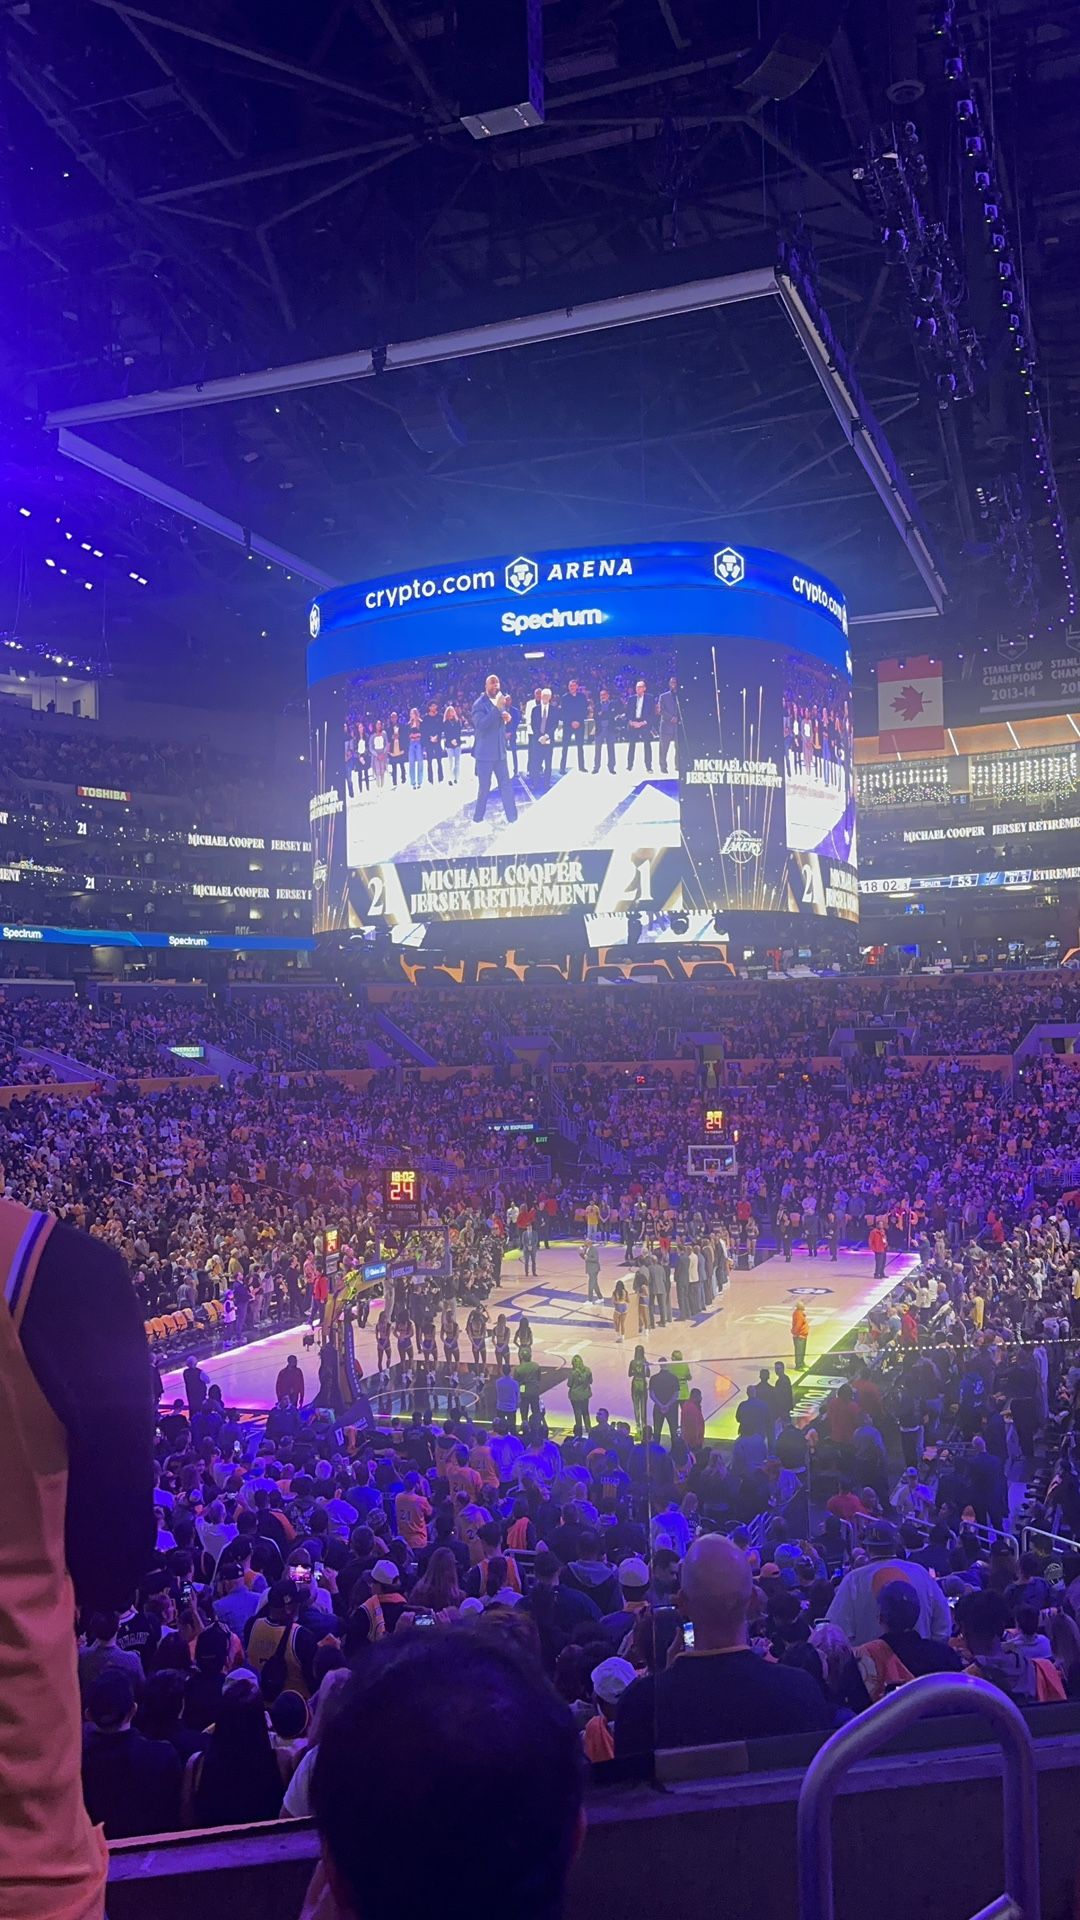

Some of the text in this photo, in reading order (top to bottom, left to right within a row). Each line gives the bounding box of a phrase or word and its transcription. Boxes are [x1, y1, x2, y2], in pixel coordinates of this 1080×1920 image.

[365, 558, 633, 609] crypto.com ARENA
[501, 608, 602, 636] Spectrum
[983, 661, 1043, 676] STANLEY CUP
[983, 671, 1043, 686] CHAMPIONS
[991, 685, 1035, 701] 2013-14
[693, 758, 777, 775] MICHAEL COOPER
[686, 771, 782, 788] JERSEY RETIREMENT
[81, 786, 127, 801] TOSHIBA
[77, 822, 87, 835] 21
[904, 830, 946, 843] MICHAEL
[946, 826, 985, 838] COOPER
[992, 821, 1027, 835] JERSEY
[188, 833, 228, 847] MICHAEL
[229, 837, 264, 849] COOPER
[271, 840, 301, 852] JERSEY
[85, 877, 95, 889] 21
[421, 861, 584, 892] MICHAEL COOPER
[958, 876, 972, 886] 53
[193, 884, 233, 898] MICHAEL
[234, 887, 270, 899] COOPER
[276, 889, 308, 900] JERSEY
[410, 883, 599, 914] JERSEY RETIREMENT
[3, 927, 41, 939] Spectrum
[169, 936, 206, 946] Spectrum
[390, 1182, 413, 1200] 24
